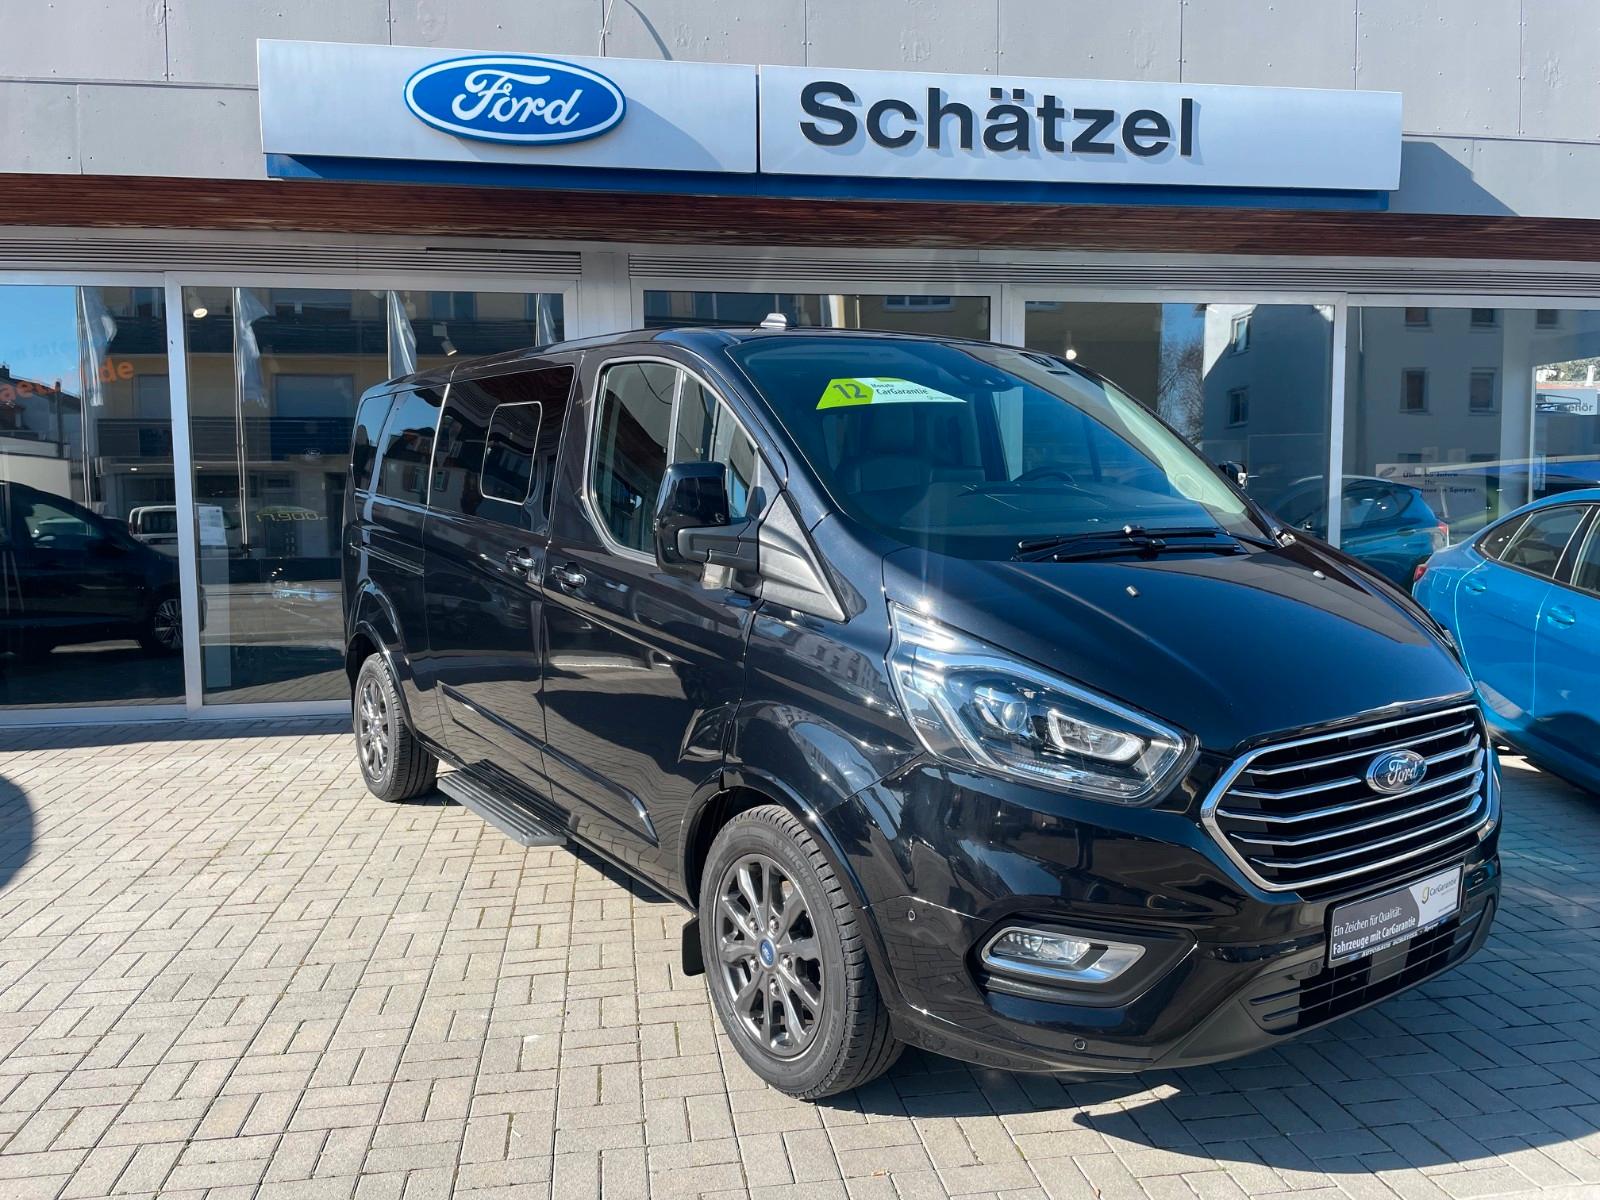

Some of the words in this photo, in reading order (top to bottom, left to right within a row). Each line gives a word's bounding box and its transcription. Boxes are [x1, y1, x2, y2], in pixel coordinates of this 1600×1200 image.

[451, 70, 583, 125] Ford
[799, 80, 1194, 157] Schätzel
[833, 383, 868, 399] 12
[876, 387, 929, 396] CarGarantie
[1387, 757, 1418, 786] Ford
[1429, 878, 1457, 897] CarGarantie
[1333, 924, 1344, 938] Ein
[1344, 918, 1369, 934] Zeichen
[1368, 913, 1379, 927] für
[1378, 907, 1403, 924] Qualität:
[1333, 936, 1370, 956] Fahrzeuge
[1369, 930, 1381, 943] mit
[1381, 915, 1417, 939] CarGarantie
